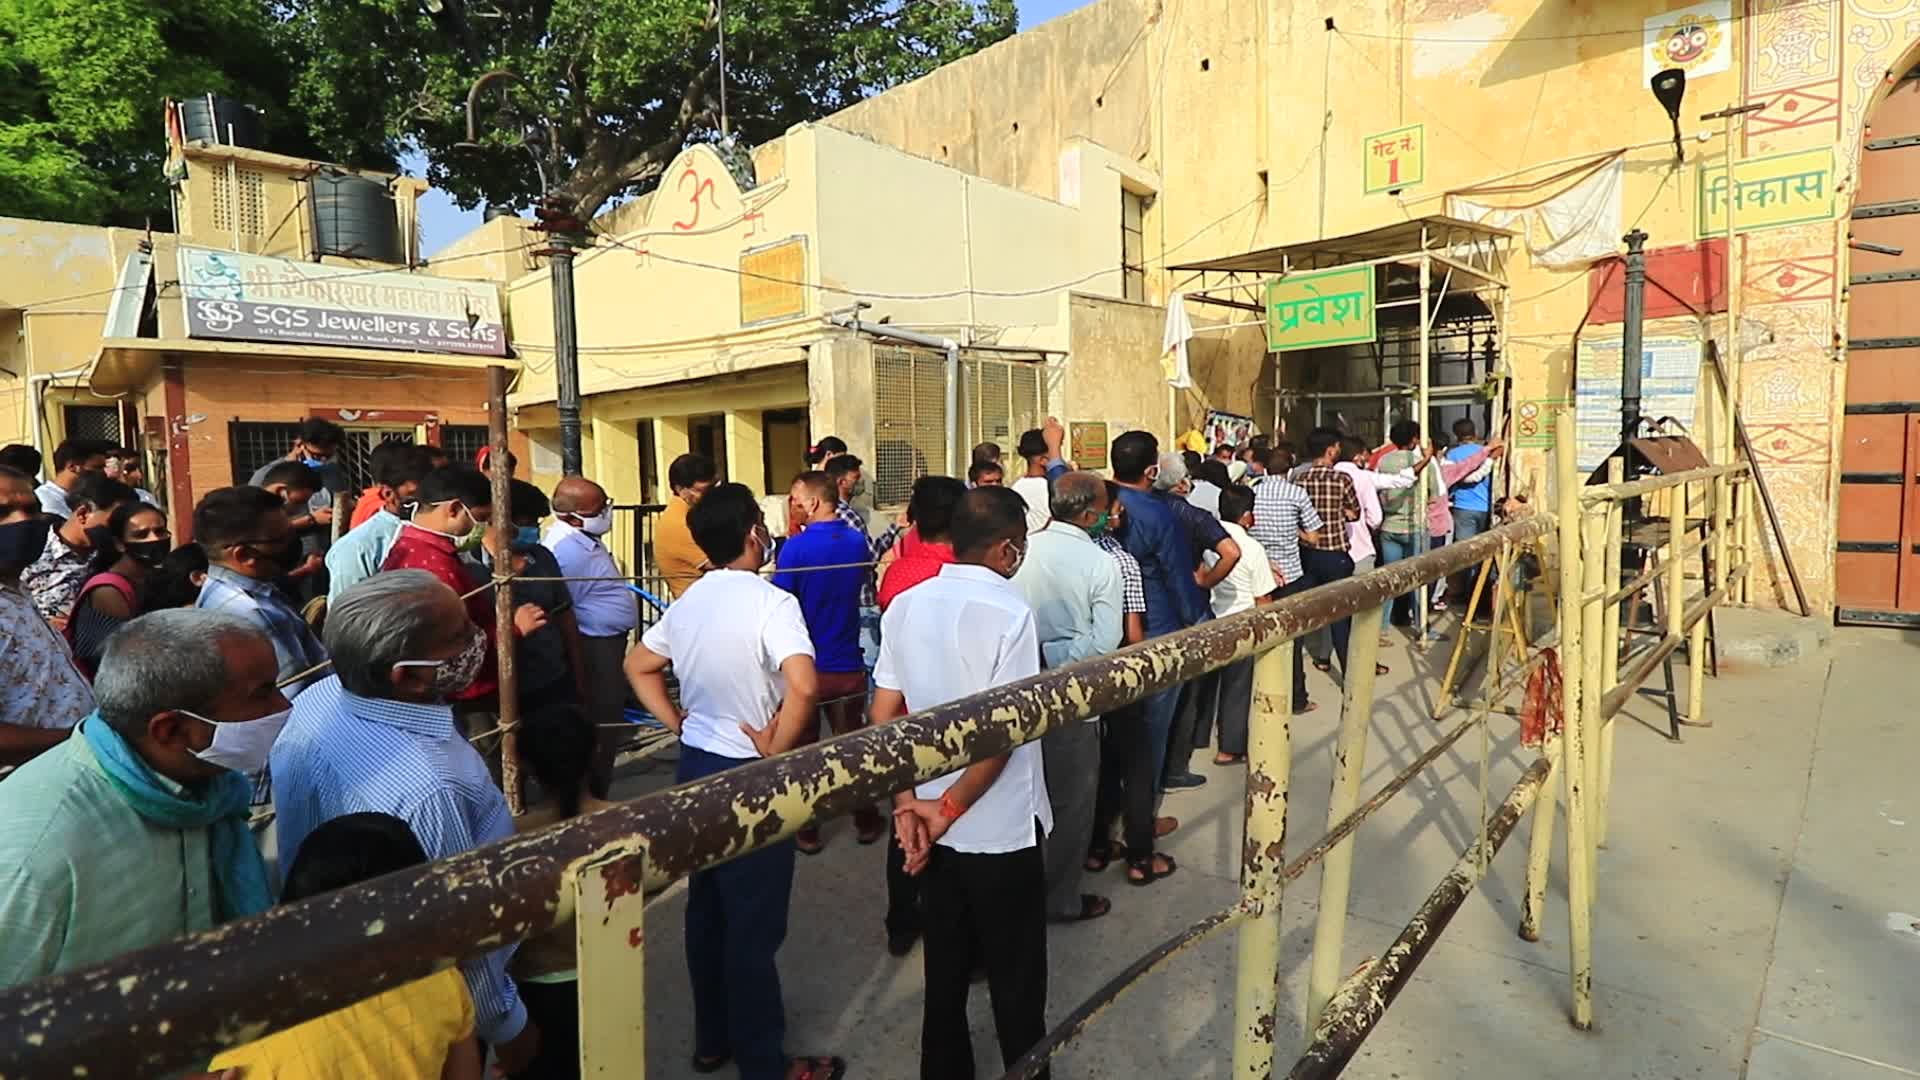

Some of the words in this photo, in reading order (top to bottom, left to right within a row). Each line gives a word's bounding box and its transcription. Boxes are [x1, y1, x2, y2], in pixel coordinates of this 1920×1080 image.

[1387, 158, 1399, 184] 1
[1705, 169, 1828, 215] निकास
[253, 305, 310, 329] SGS
[317, 311, 420, 336] Jewellers
[427, 320, 441, 338] &
[446, 321, 497, 342] Sons
[1274, 283, 1367, 333] प्रवेश
